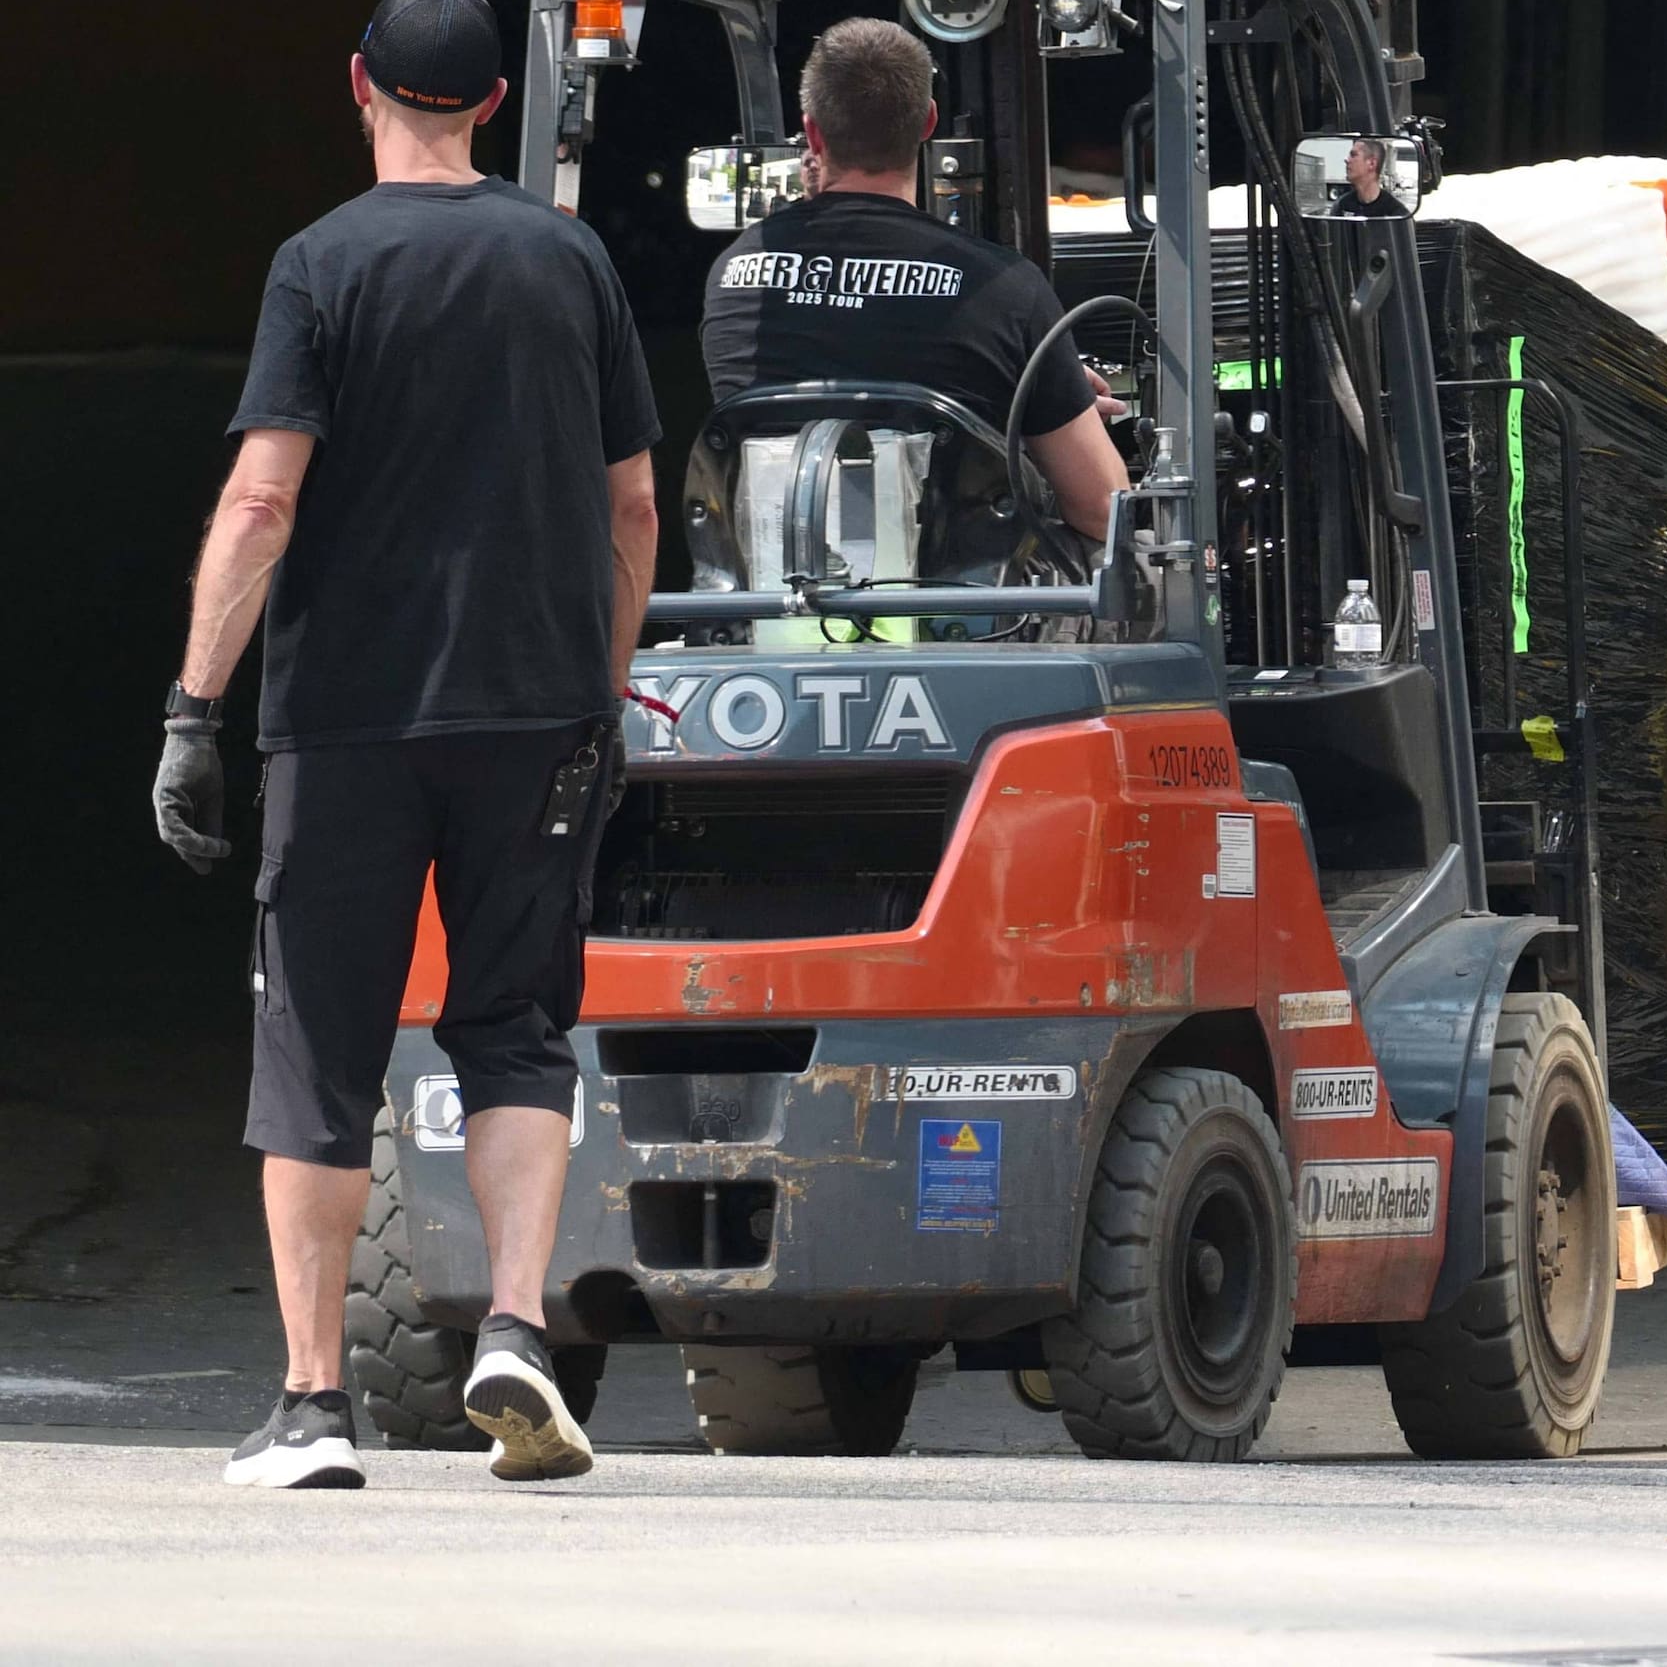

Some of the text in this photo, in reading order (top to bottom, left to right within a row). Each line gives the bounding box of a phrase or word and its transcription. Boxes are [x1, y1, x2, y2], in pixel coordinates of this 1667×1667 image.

[803, 255, 833, 293] &
[839, 257, 964, 297] WEIRDER
[786, 290, 864, 309] 2025 TOUR
[632, 675, 949, 751] YOTA
[1149, 746, 1231, 787] 12074389
[1295, 1079, 1374, 1109] 800-UR-RENTS
[1325, 1175, 1431, 1223] United Rentals
